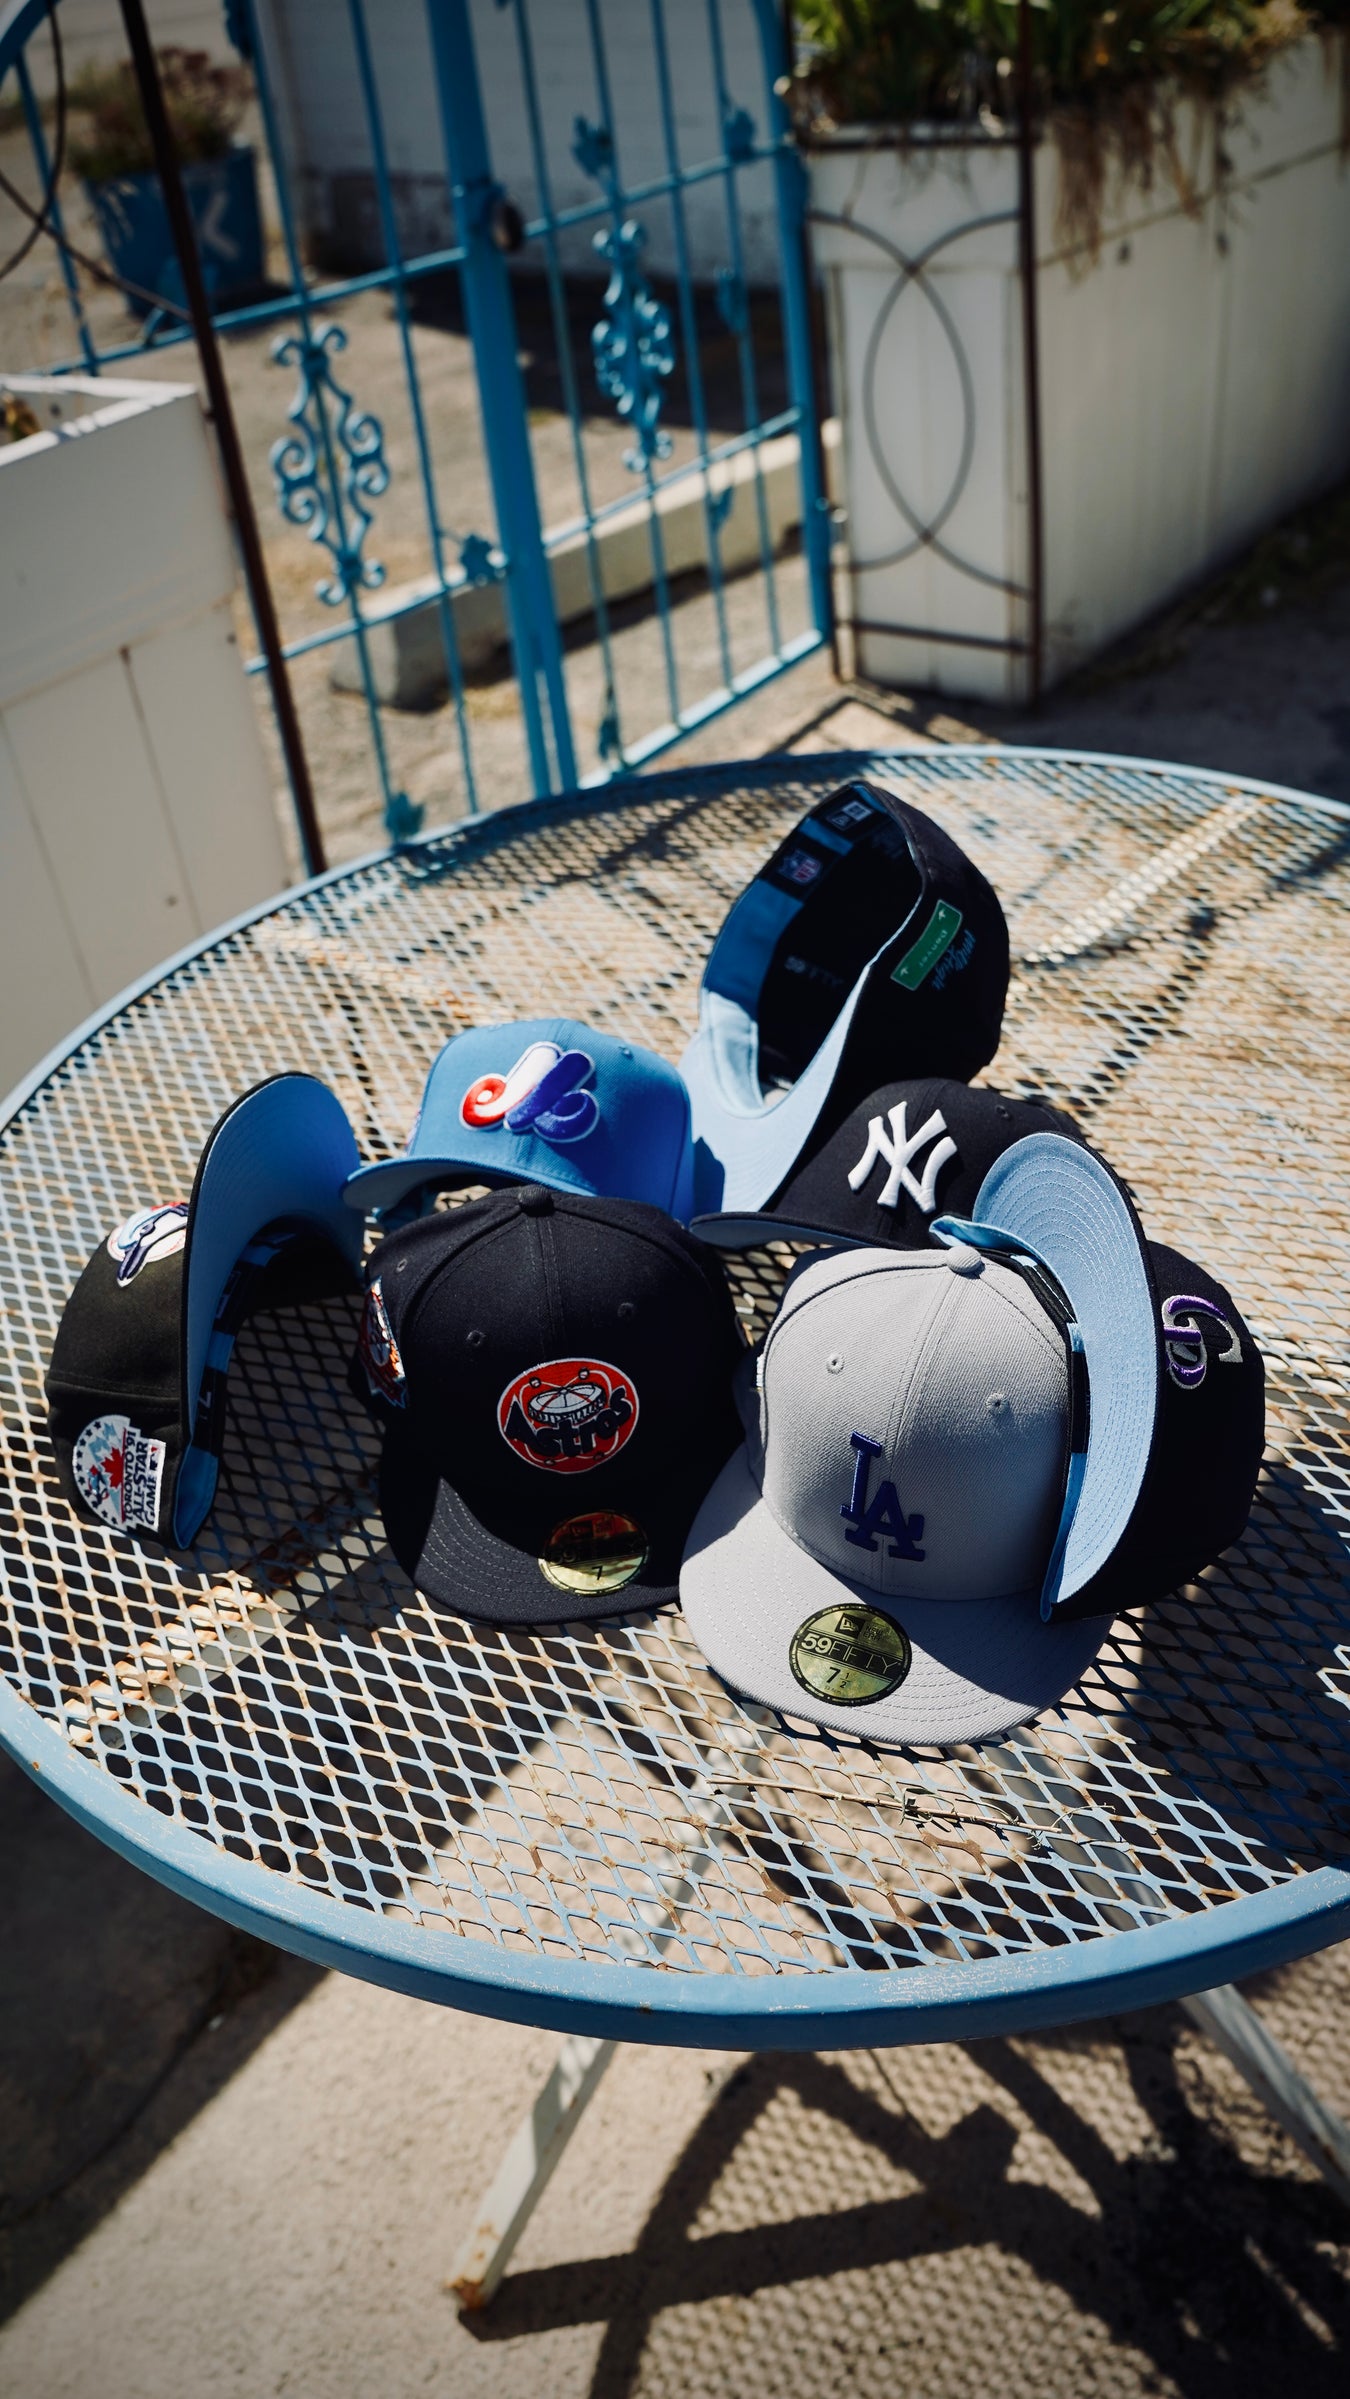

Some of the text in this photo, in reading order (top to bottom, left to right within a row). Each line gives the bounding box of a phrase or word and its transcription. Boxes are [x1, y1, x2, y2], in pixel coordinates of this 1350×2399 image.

[847, 1101, 958, 1213] NY
[503, 1384, 634, 1458] Astros
[124, 1451, 134, 1521] TORONTO
[133, 1441, 148, 1523] ALL-STAR
[144, 1476, 157, 1526] GAME
[839, 1430, 925, 1562] LA
[800, 1632, 899, 1675] 59FIFTY
[826, 1666, 841, 1684] 7
